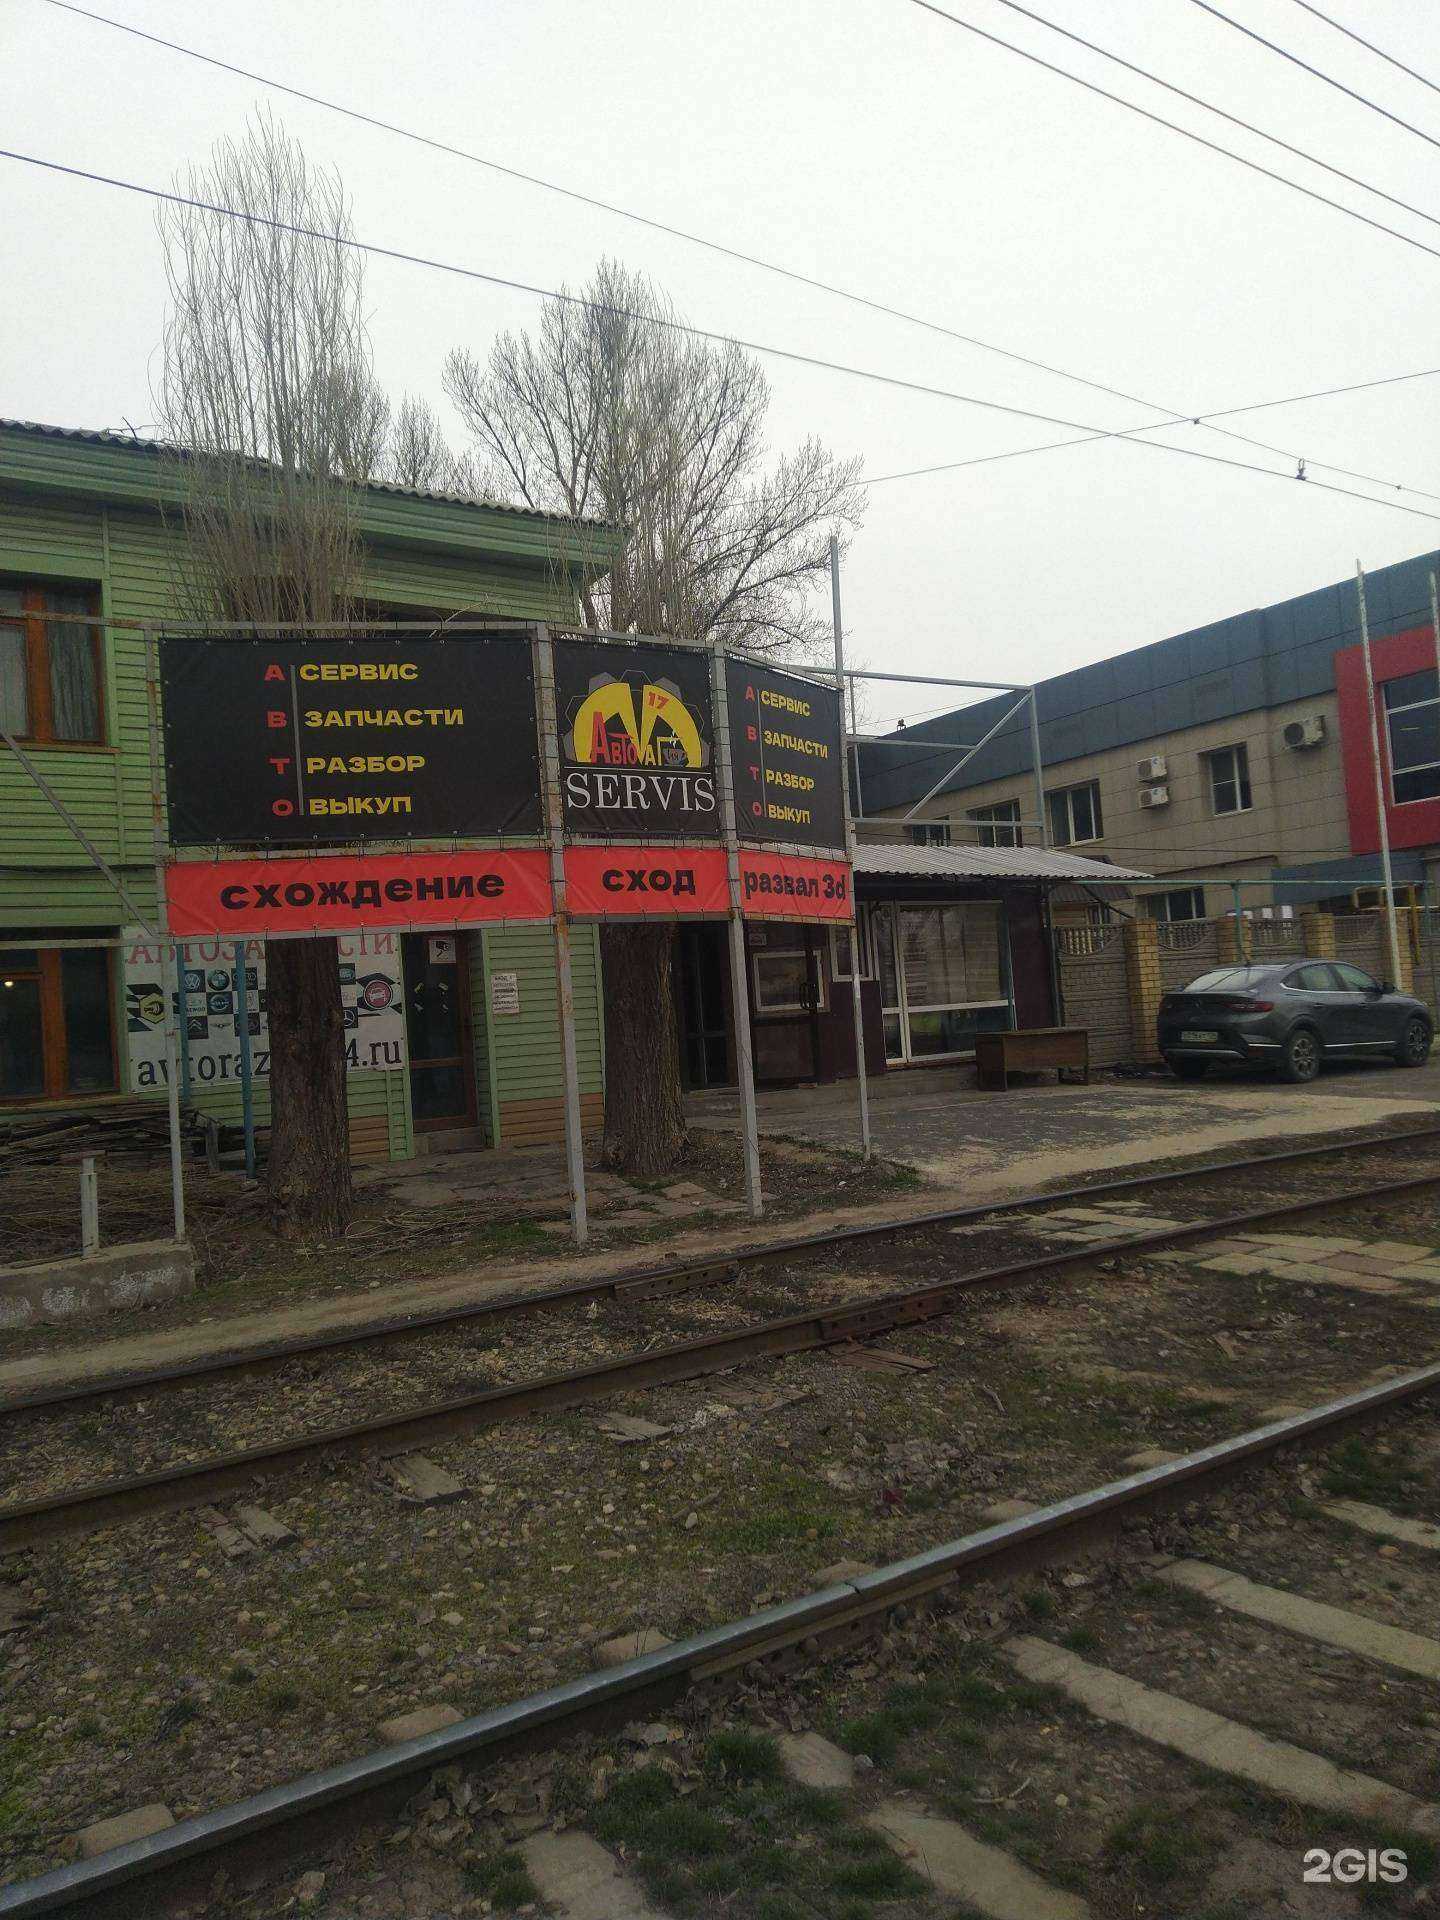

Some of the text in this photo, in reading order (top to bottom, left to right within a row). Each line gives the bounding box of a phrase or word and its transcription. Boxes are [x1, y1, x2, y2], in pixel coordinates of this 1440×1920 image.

[300, 663, 418, 682] СЕРВИС
[648, 691, 670, 710] 17
[760, 689, 811, 717] СЕРВИС
[304, 708, 464, 728] ЗАПЧАСТИ
[763, 730, 828, 759] ЗАПЧАСТИ
[306, 755, 426, 774] РАЗБОР
[765, 768, 815, 791] РАЗБОР
[566, 772, 716, 812] SERVIS
[310, 796, 412, 816] ВЫКУП
[768, 803, 812, 825] ВЫКУП
[219, 873, 505, 911] схождение
[602, 868, 696, 896] сход
[744, 870, 846, 900] развал 3d
